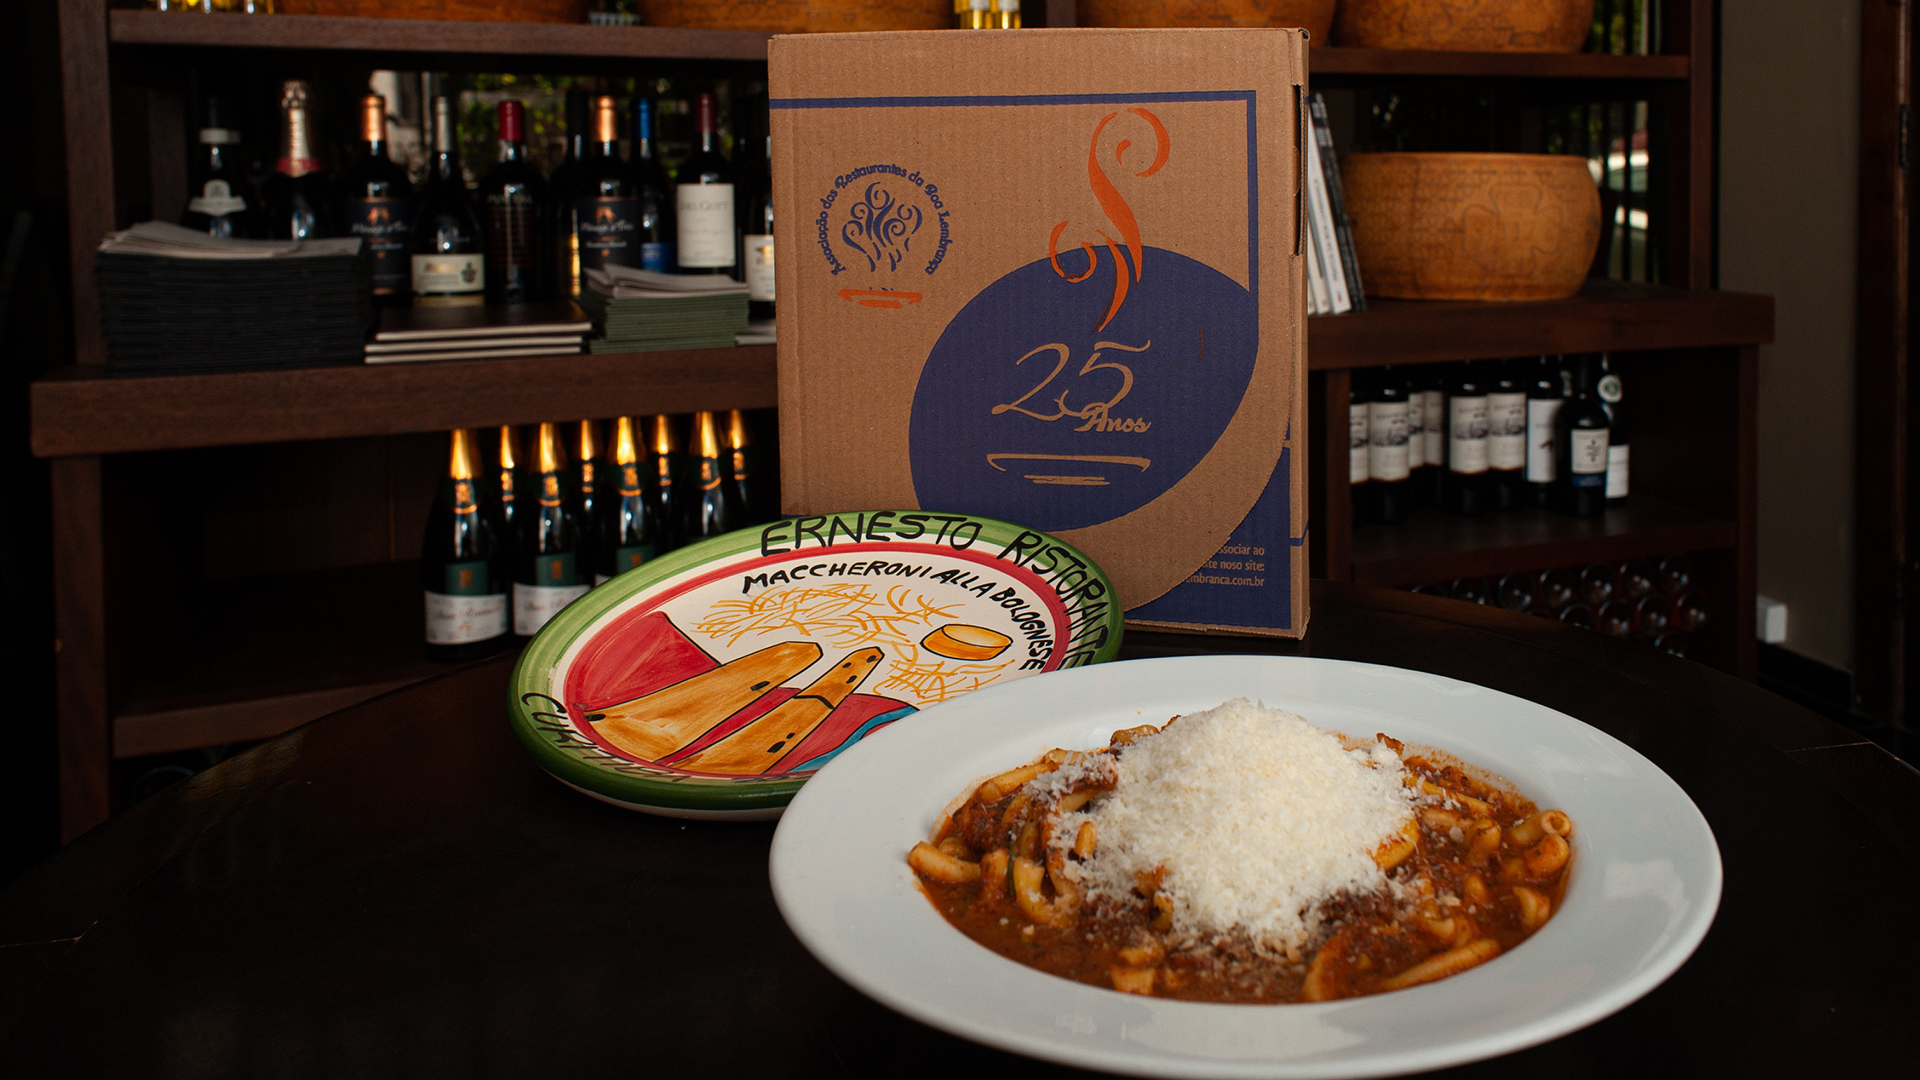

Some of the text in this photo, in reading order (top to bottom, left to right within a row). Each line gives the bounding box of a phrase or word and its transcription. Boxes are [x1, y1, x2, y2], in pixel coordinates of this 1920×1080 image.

[834, 163, 907, 189] Restaurantes
[908, 171, 925, 187] da
[820, 189, 838, 210] dos
[924, 183, 944, 210] Boa
[924, 210, 953, 275] Lembrança
[991, 339, 1151, 421] 25
[1073, 402, 1152, 433] Anos
[1252, 547, 1265, 556] ao
[1220, 561, 1243, 570] noso
[760, 511, 1109, 672] ERNESTO RISTORANTE
[742, 560, 1054, 670] MACCHERONI ALLA BOLOGNESE
